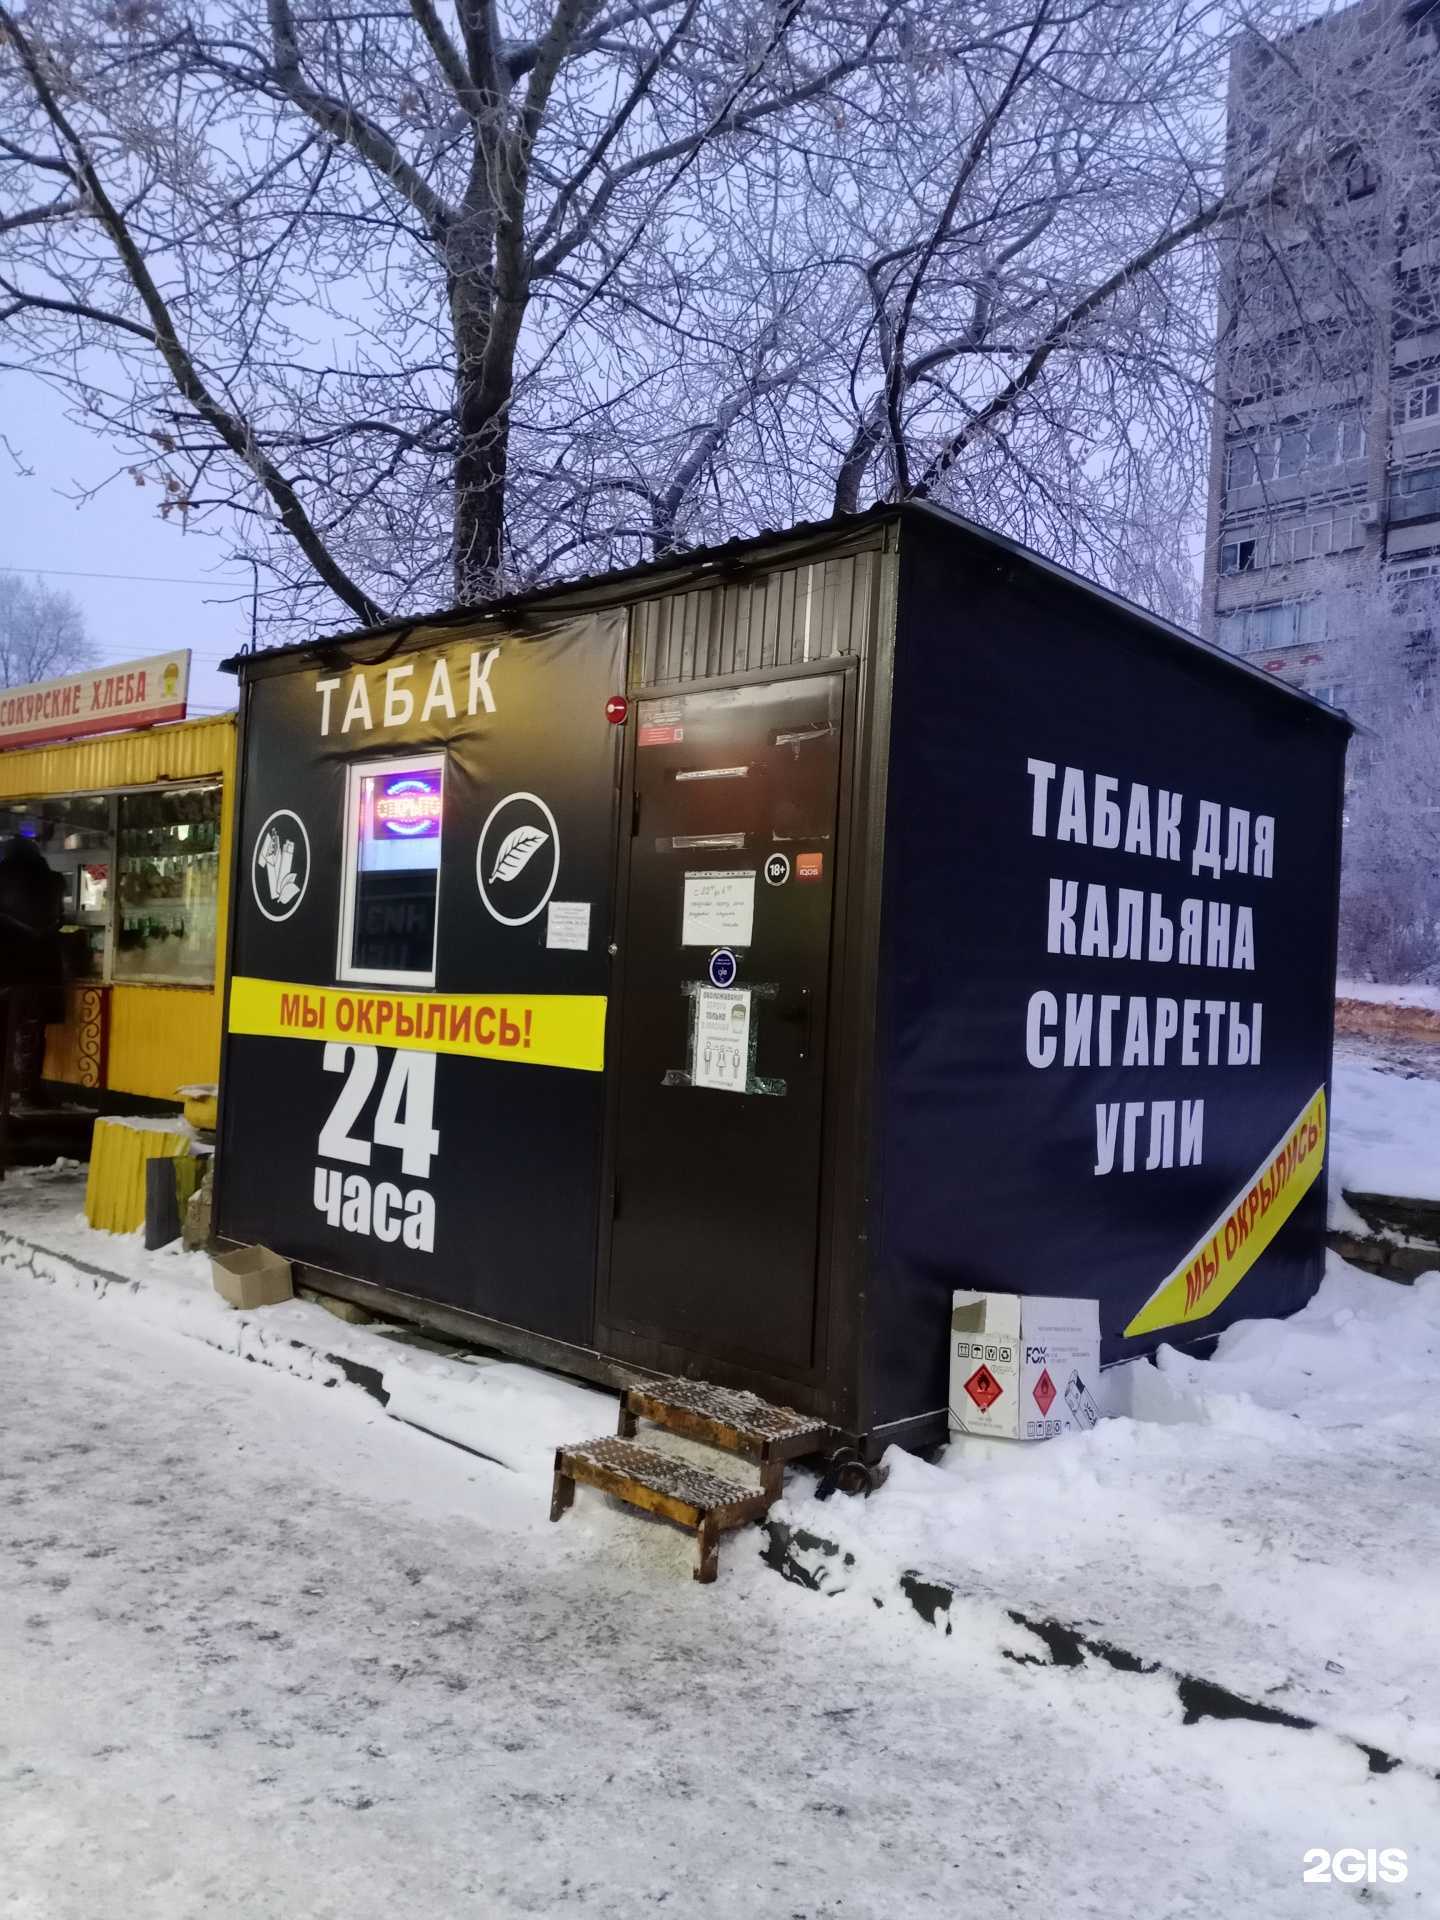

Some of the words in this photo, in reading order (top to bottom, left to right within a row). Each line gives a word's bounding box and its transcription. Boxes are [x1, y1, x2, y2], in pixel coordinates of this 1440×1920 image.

[0, 684, 81, 727] СОКУРСКИЕ
[91, 671, 146, 711] ХЛЕБА
[315, 648, 501, 736] ТАБАК
[1027, 757, 1183, 862] ТАБАК
[1191, 800, 1275, 880] ДЛЯ
[769, 863, 786, 876] 18+
[1047, 878, 1255, 971] КАЛЬЯНА
[280, 992, 325, 1030] МЫ
[335, 997, 533, 1048] ОКРЫЛИСЬ!
[1026, 990, 1263, 1069] СИГАРЕТЫ
[317, 1041, 440, 1179] 24
[1094, 1099, 1204, 1176] УГЛИ
[313, 1166, 436, 1253] часа
[1183, 1238, 1219, 1317] МЫ
[1224, 1103, 1322, 1262] ОКРЫЛИСЬ!
[1026, 1347, 1047, 1364] FOX
